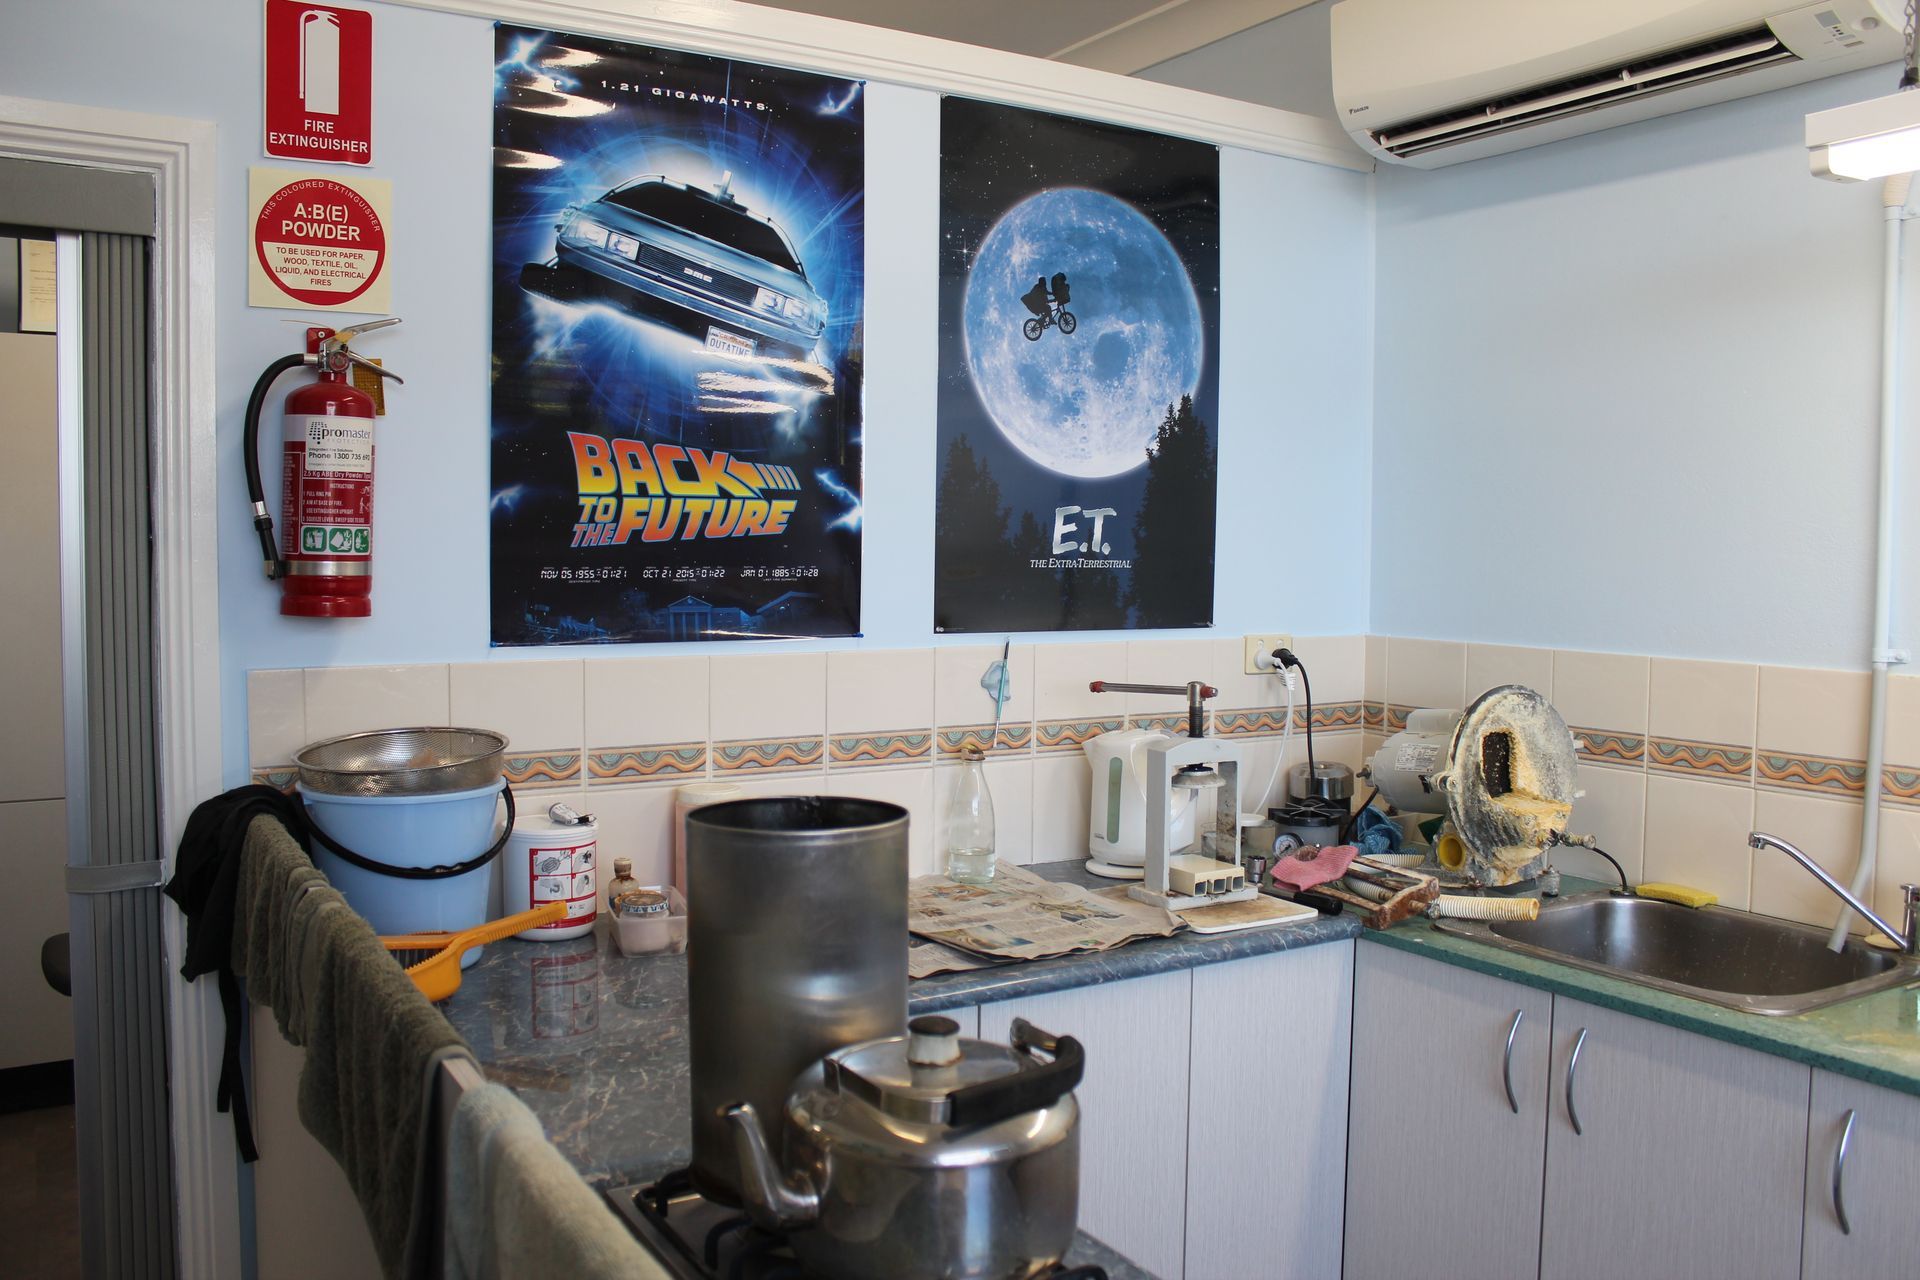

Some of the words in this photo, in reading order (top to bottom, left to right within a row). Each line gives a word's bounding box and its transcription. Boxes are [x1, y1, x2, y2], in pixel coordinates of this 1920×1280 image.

[601, 80, 640, 93] 1.21
[304, 119, 334, 134] FIRE
[269, 131, 368, 153] EXTINGUISHER
[261, 201, 277, 220] THIS
[275, 181, 325, 201] COLOURED
[328, 183, 381, 232] EXTINGUISHER
[293, 202, 349, 224] A:B(E)
[281, 220, 361, 242] POWDER
[276, 246, 287, 255] TO
[288, 247, 298, 255] BE
[300, 248, 320, 257] USED
[322, 250, 338, 258] FOR
[303, 268, 320, 276] AND
[320, 269, 366, 279] ELECTRICAL
[310, 278, 332, 286] FIRES
[321, 428, 371, 440] promaster
[334, 452, 350, 460] 1300
[566, 430, 780, 498] BACK
[334, 471, 345, 479] Dry
[578, 496, 618, 523] TO
[611, 496, 798, 544] FUTURE
[570, 523, 616, 548] THE
[1052, 505, 1117, 555] E.T.
[1029, 559, 1048, 568] THE
[540, 570, 559, 579] NOV
[561, 570, 572, 578] 05
[575, 570, 595, 578] 1955
[642, 569, 659, 578] OCT
[661, 569, 671, 578] 21
[675, 569, 695, 578] 2015
[740, 569, 756, 577] JAN
[758, 568, 768, 577] 01
[772, 568, 790, 577] 1885
[796, 568, 819, 577] 01:28
